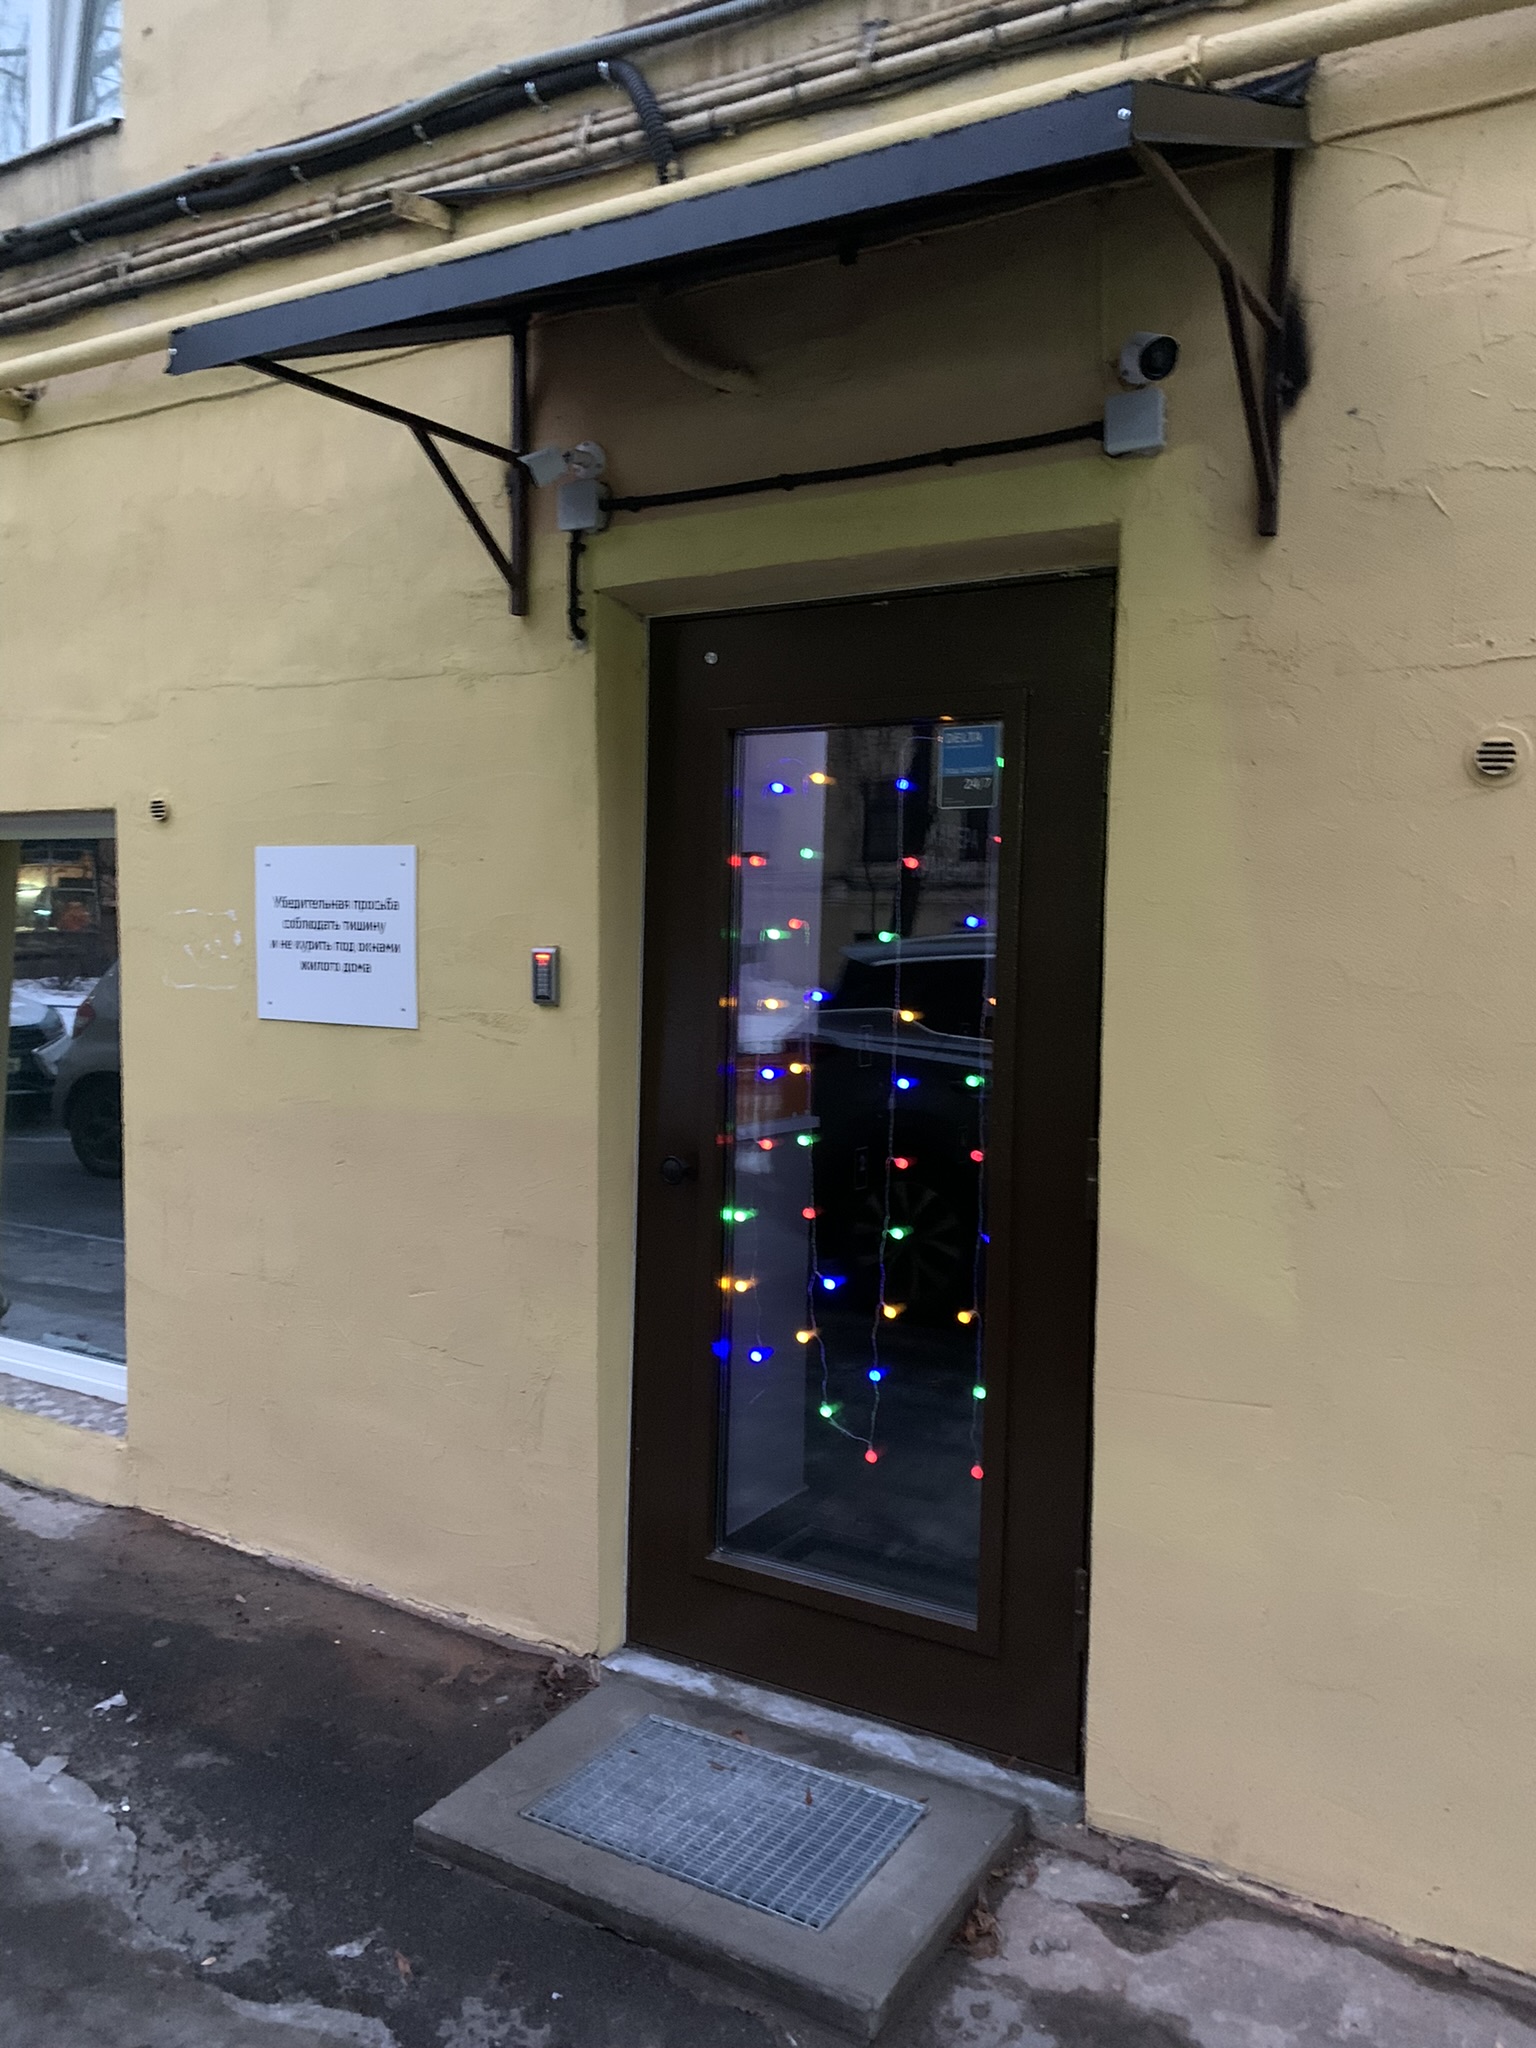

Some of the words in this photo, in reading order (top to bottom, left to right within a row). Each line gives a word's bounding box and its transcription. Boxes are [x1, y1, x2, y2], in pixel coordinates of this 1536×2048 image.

[944, 731, 983, 744] DELTA
[273, 896, 350, 910] Убедительная
[354, 897, 400, 912] просьба
[282, 917, 341, 930] соблюдать
[343, 921, 387, 935] тишину
[281, 940, 293, 949] не
[295, 940, 332, 953] курить
[334, 941, 356, 953] под
[358, 942, 401, 953] окнами
[300, 961, 341, 972] жилого
[343, 962, 372, 973] дома
